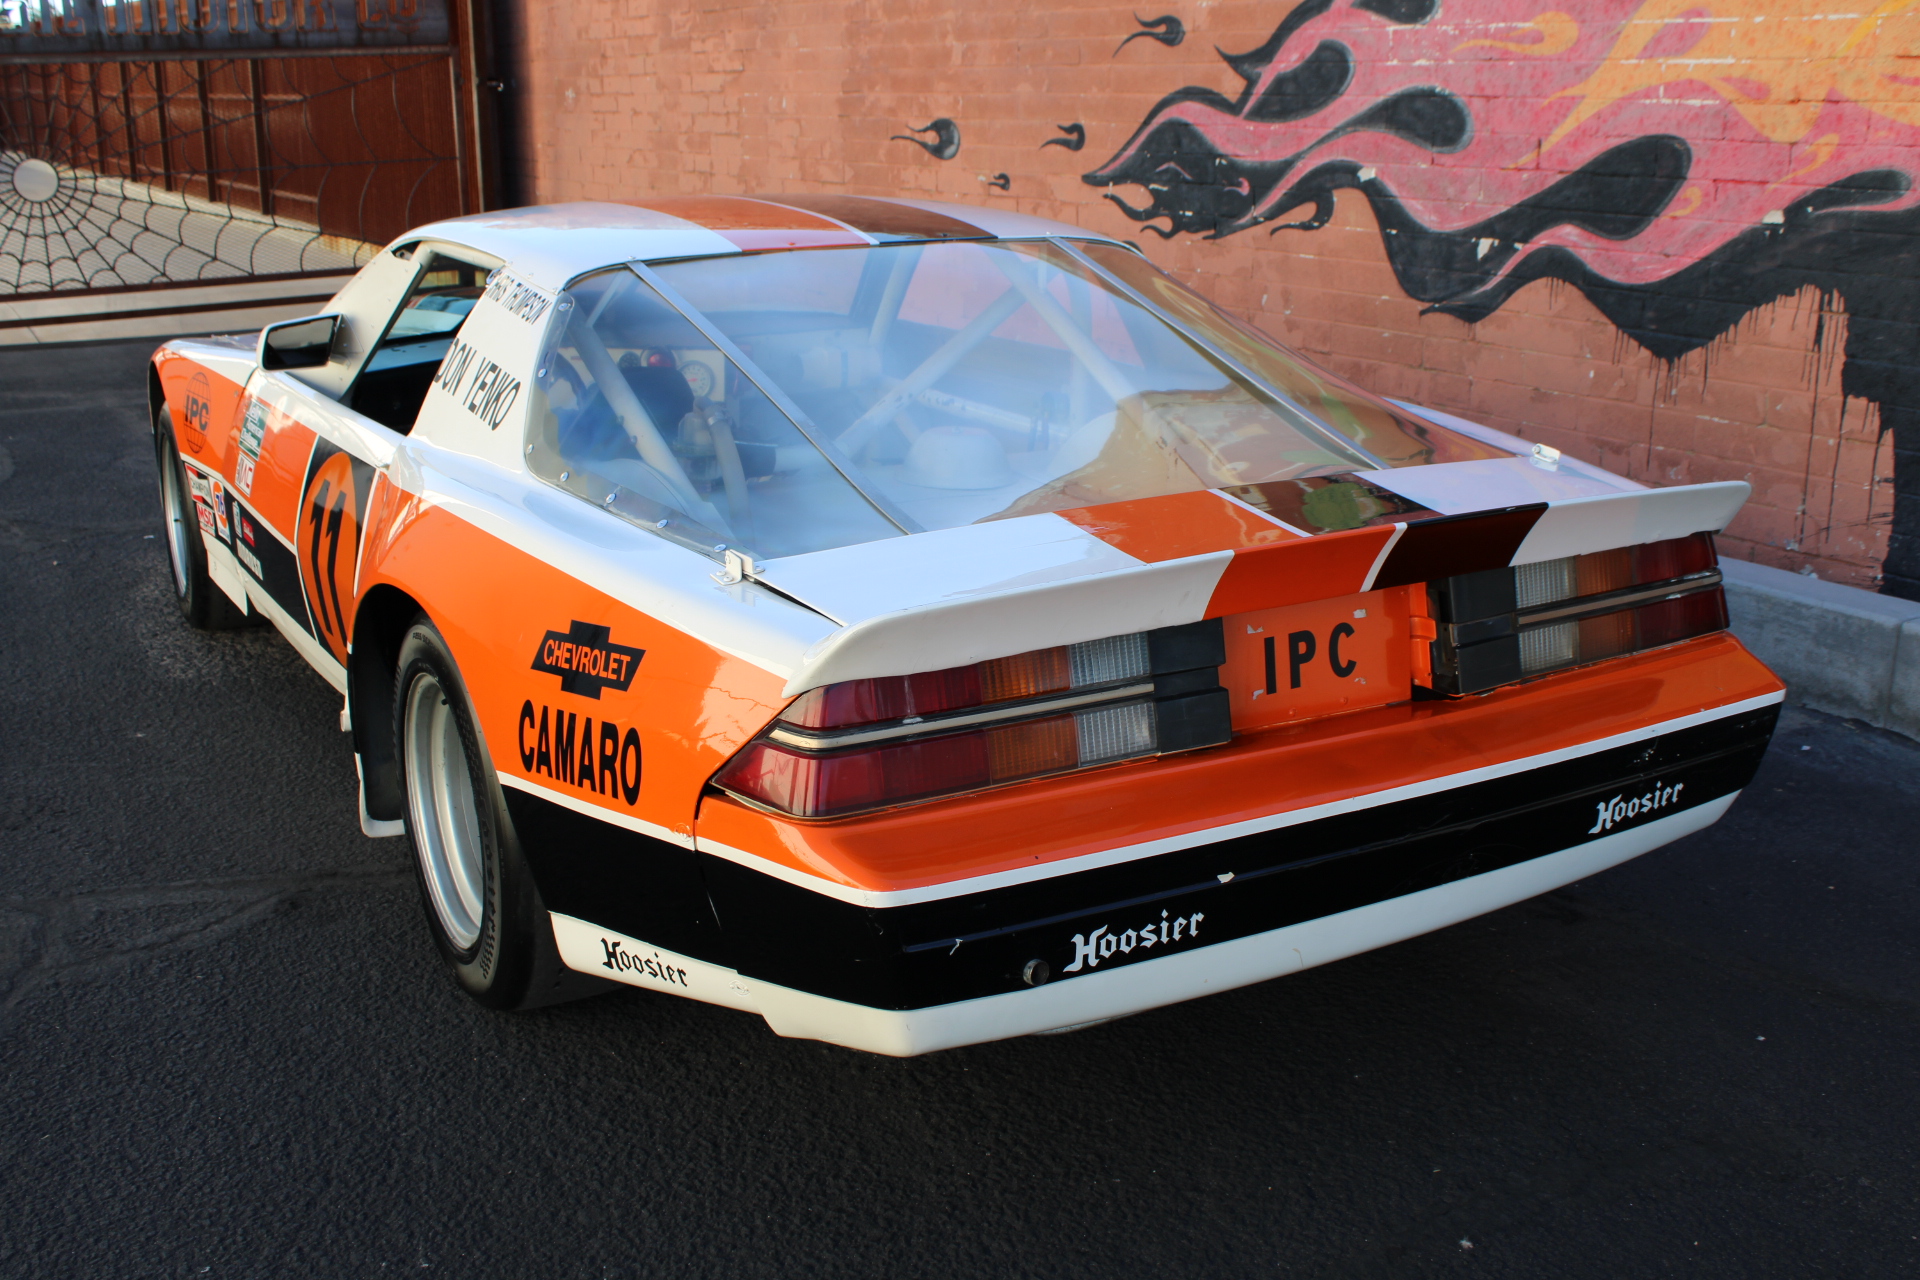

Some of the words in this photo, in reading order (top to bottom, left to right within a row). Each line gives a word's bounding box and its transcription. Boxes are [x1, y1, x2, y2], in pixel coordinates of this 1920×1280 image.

[502, 282, 553, 325] THOMPSON
[184, 394, 210, 432] IPC
[463, 357, 521, 431] YENKO
[197, 504, 215, 528] MSD
[214, 491, 225, 516] 76
[309, 478, 349, 650] 11
[543, 638, 631, 682] CHEVROLET
[1264, 622, 1357, 695] IPC
[518, 699, 642, 806] CAMARO
[1587, 780, 1685, 835] Hoosier
[600, 936, 688, 988] Hoosier
[1063, 909, 1205, 973] Hoosier
